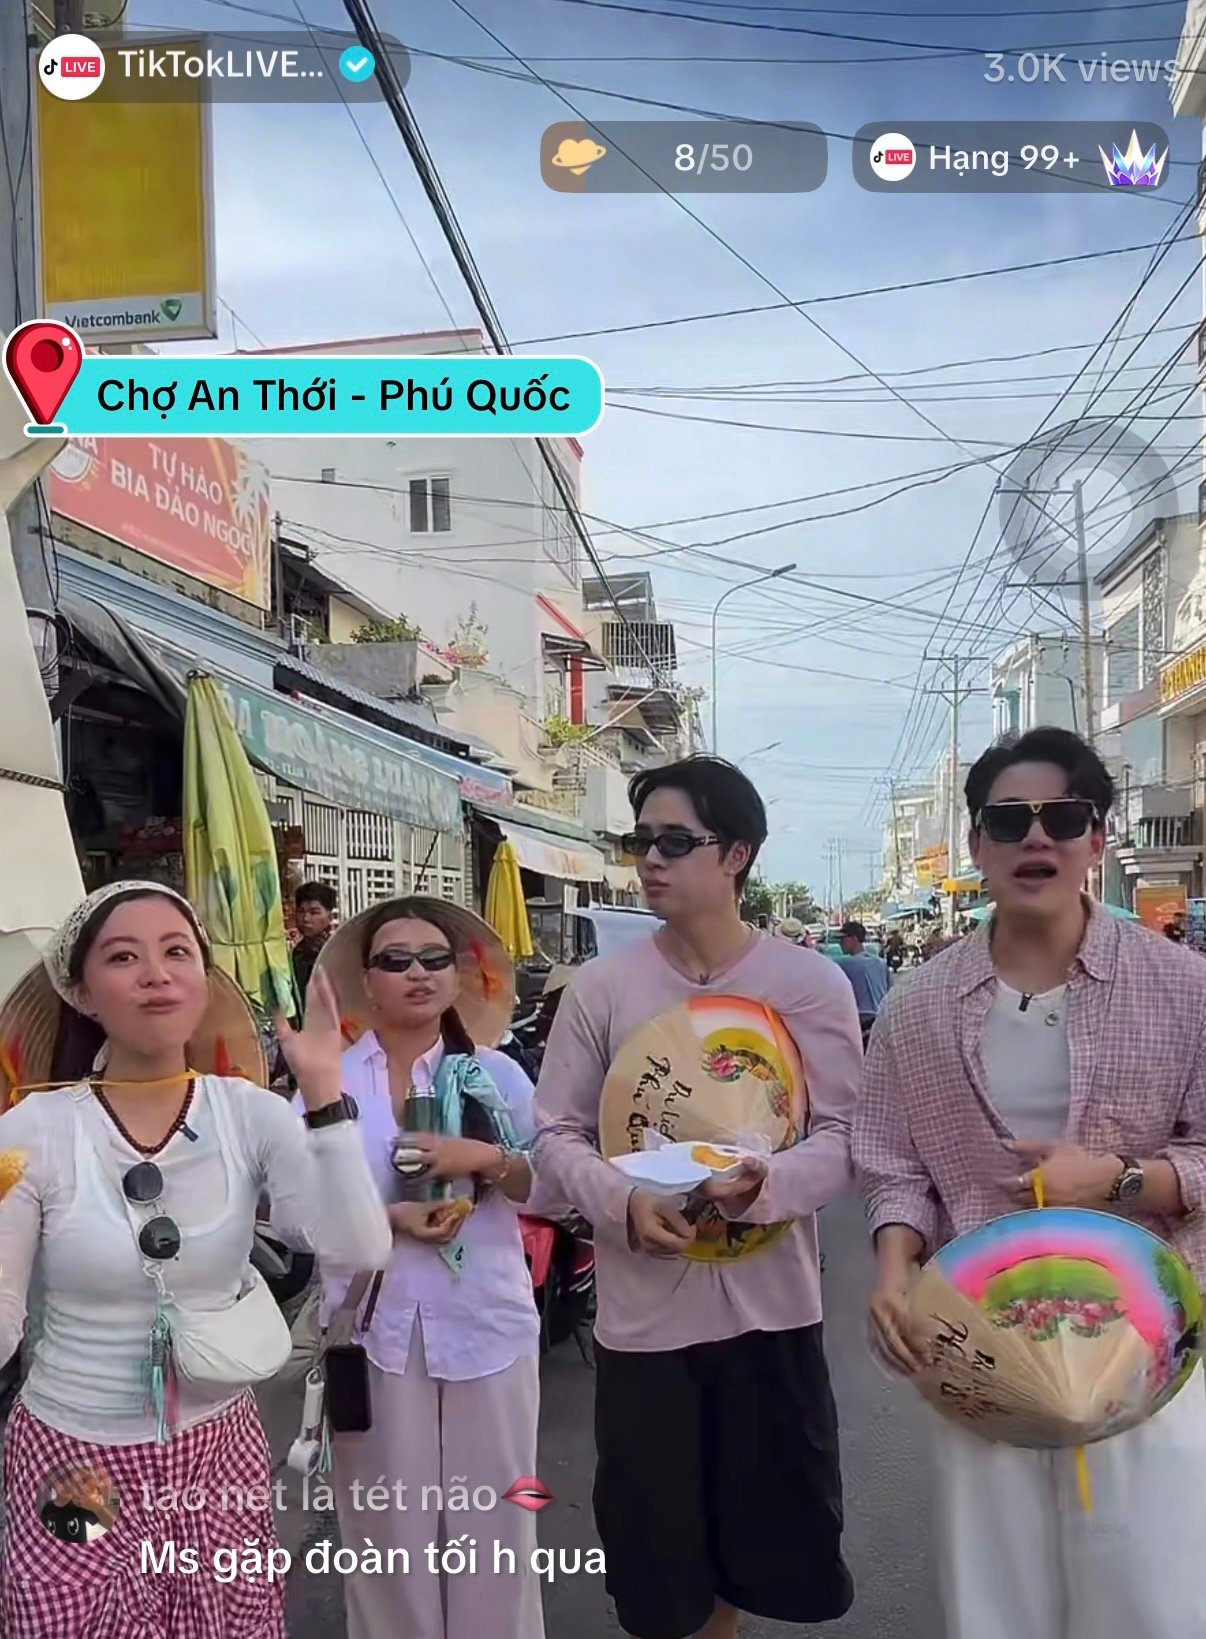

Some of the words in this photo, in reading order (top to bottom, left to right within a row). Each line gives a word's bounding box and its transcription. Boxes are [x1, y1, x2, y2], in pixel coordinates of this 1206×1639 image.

[64, 310, 160, 329] Vietcombank
[111, 458, 150, 503] BIA
[154, 482, 200, 528] ĐẢO
[180, 461, 223, 505] HÀO
